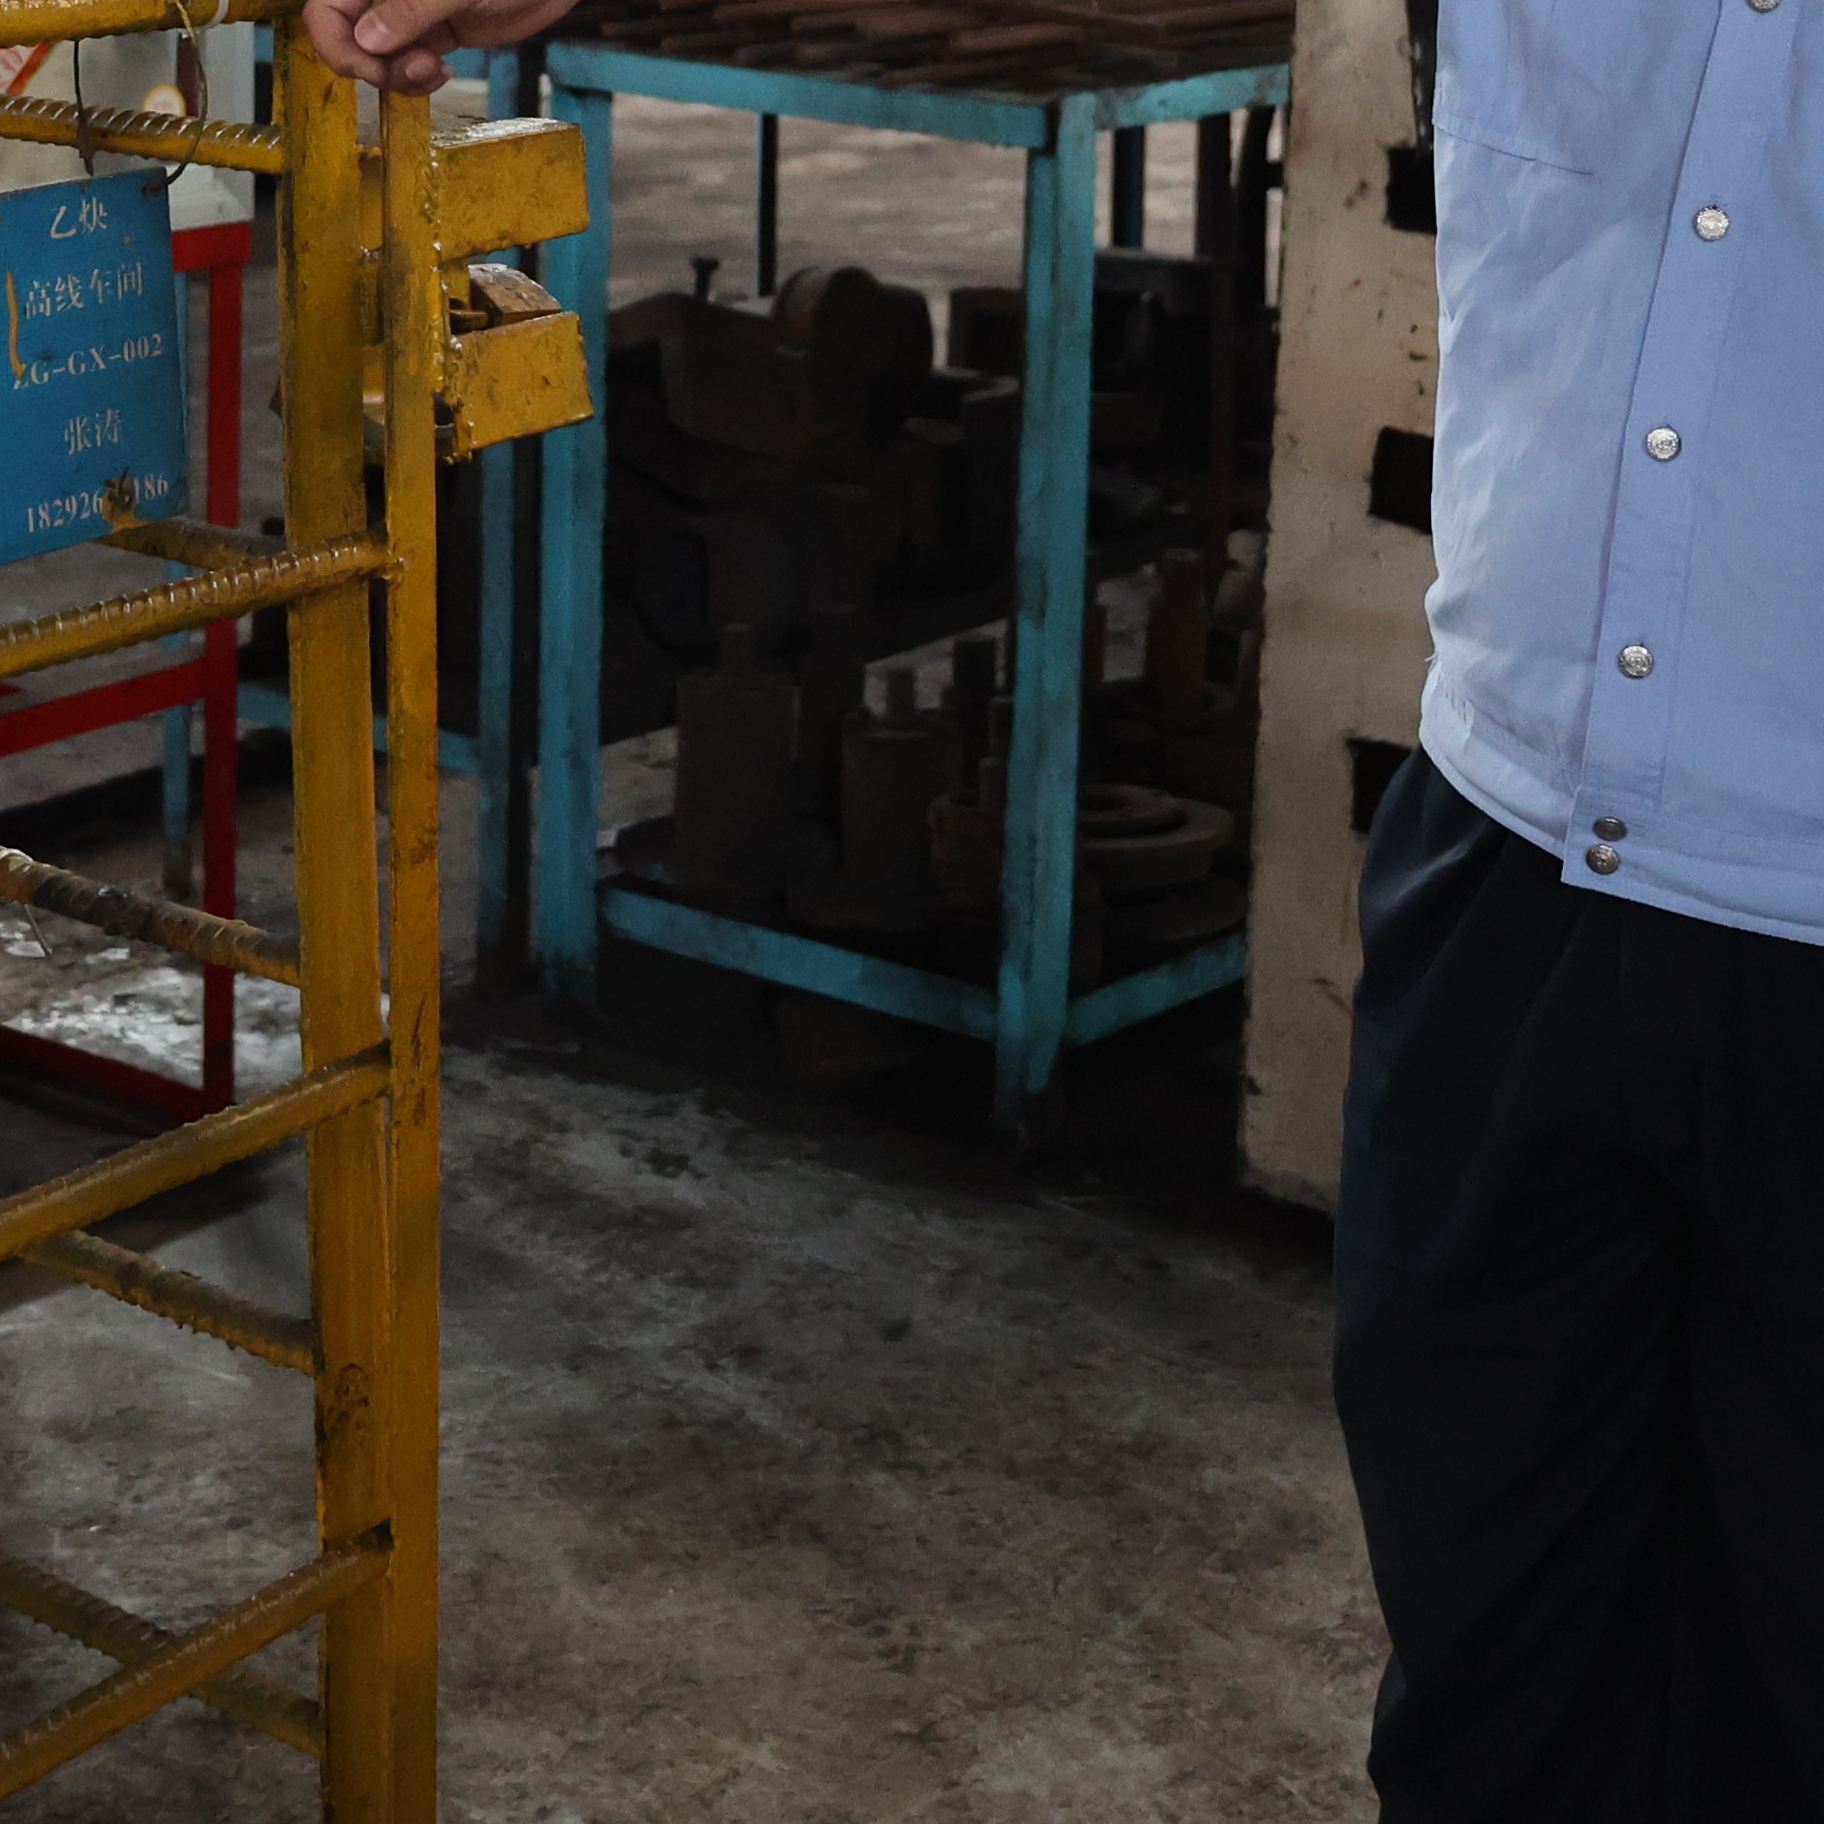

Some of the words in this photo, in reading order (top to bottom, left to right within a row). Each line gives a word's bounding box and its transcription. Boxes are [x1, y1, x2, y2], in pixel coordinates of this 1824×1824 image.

[50, 197, 108, 238] 乙炔
[26, 262, 143, 319] 高线车间
[27, 474, 169, 533] 182926186
